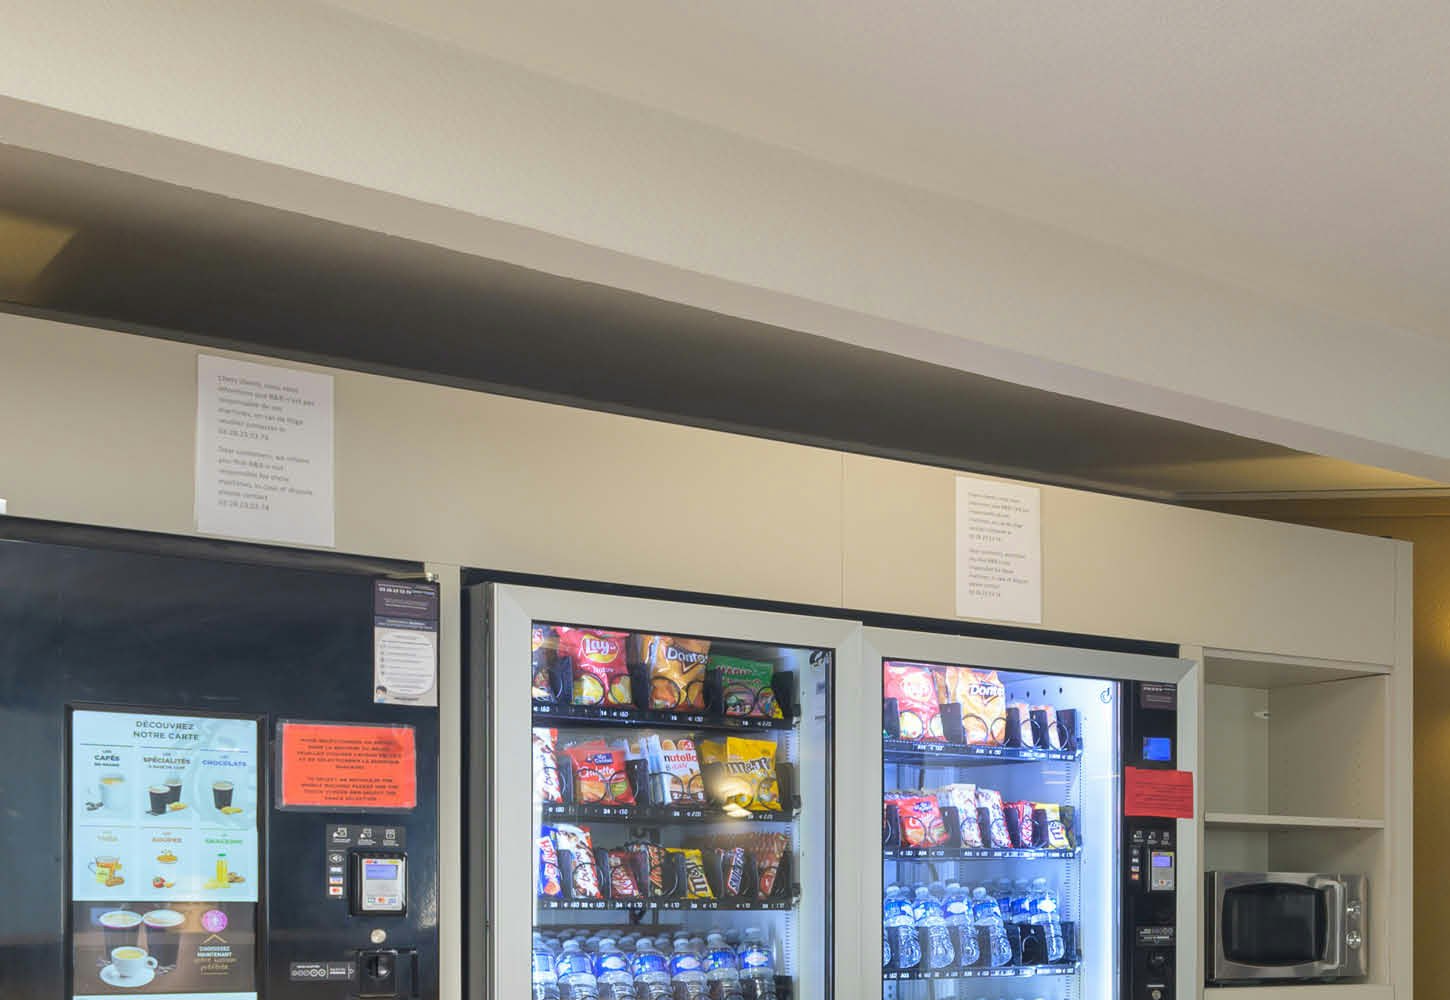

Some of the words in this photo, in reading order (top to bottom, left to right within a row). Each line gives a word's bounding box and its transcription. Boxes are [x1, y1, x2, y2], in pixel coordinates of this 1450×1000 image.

[136, 720, 195, 731] DÉCOUVREZ
[133, 731, 166, 740] NOTRE
[168, 732, 199, 741] CARTE
